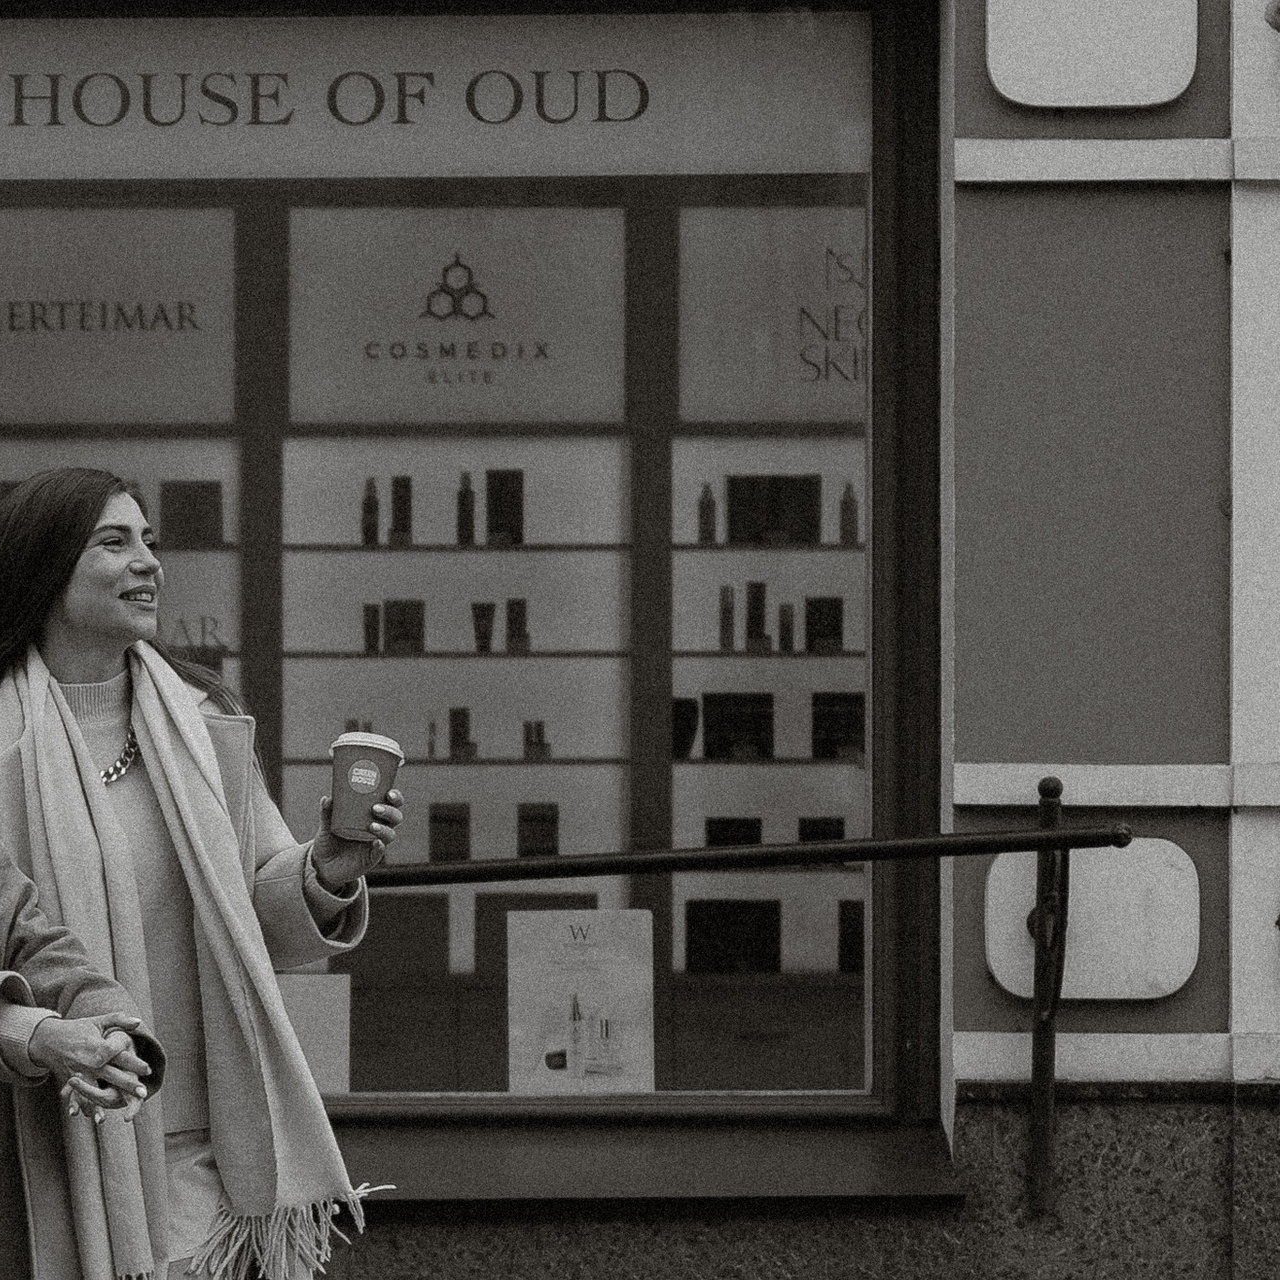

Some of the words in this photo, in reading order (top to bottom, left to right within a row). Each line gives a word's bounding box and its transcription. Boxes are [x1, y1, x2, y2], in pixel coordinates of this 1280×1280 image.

[6, 70, 294, 127] HOUSE
[326, 70, 436, 126] OF
[465, 68, 651, 124] OUD
[364, 341, 549, 361] COSMEDIX
